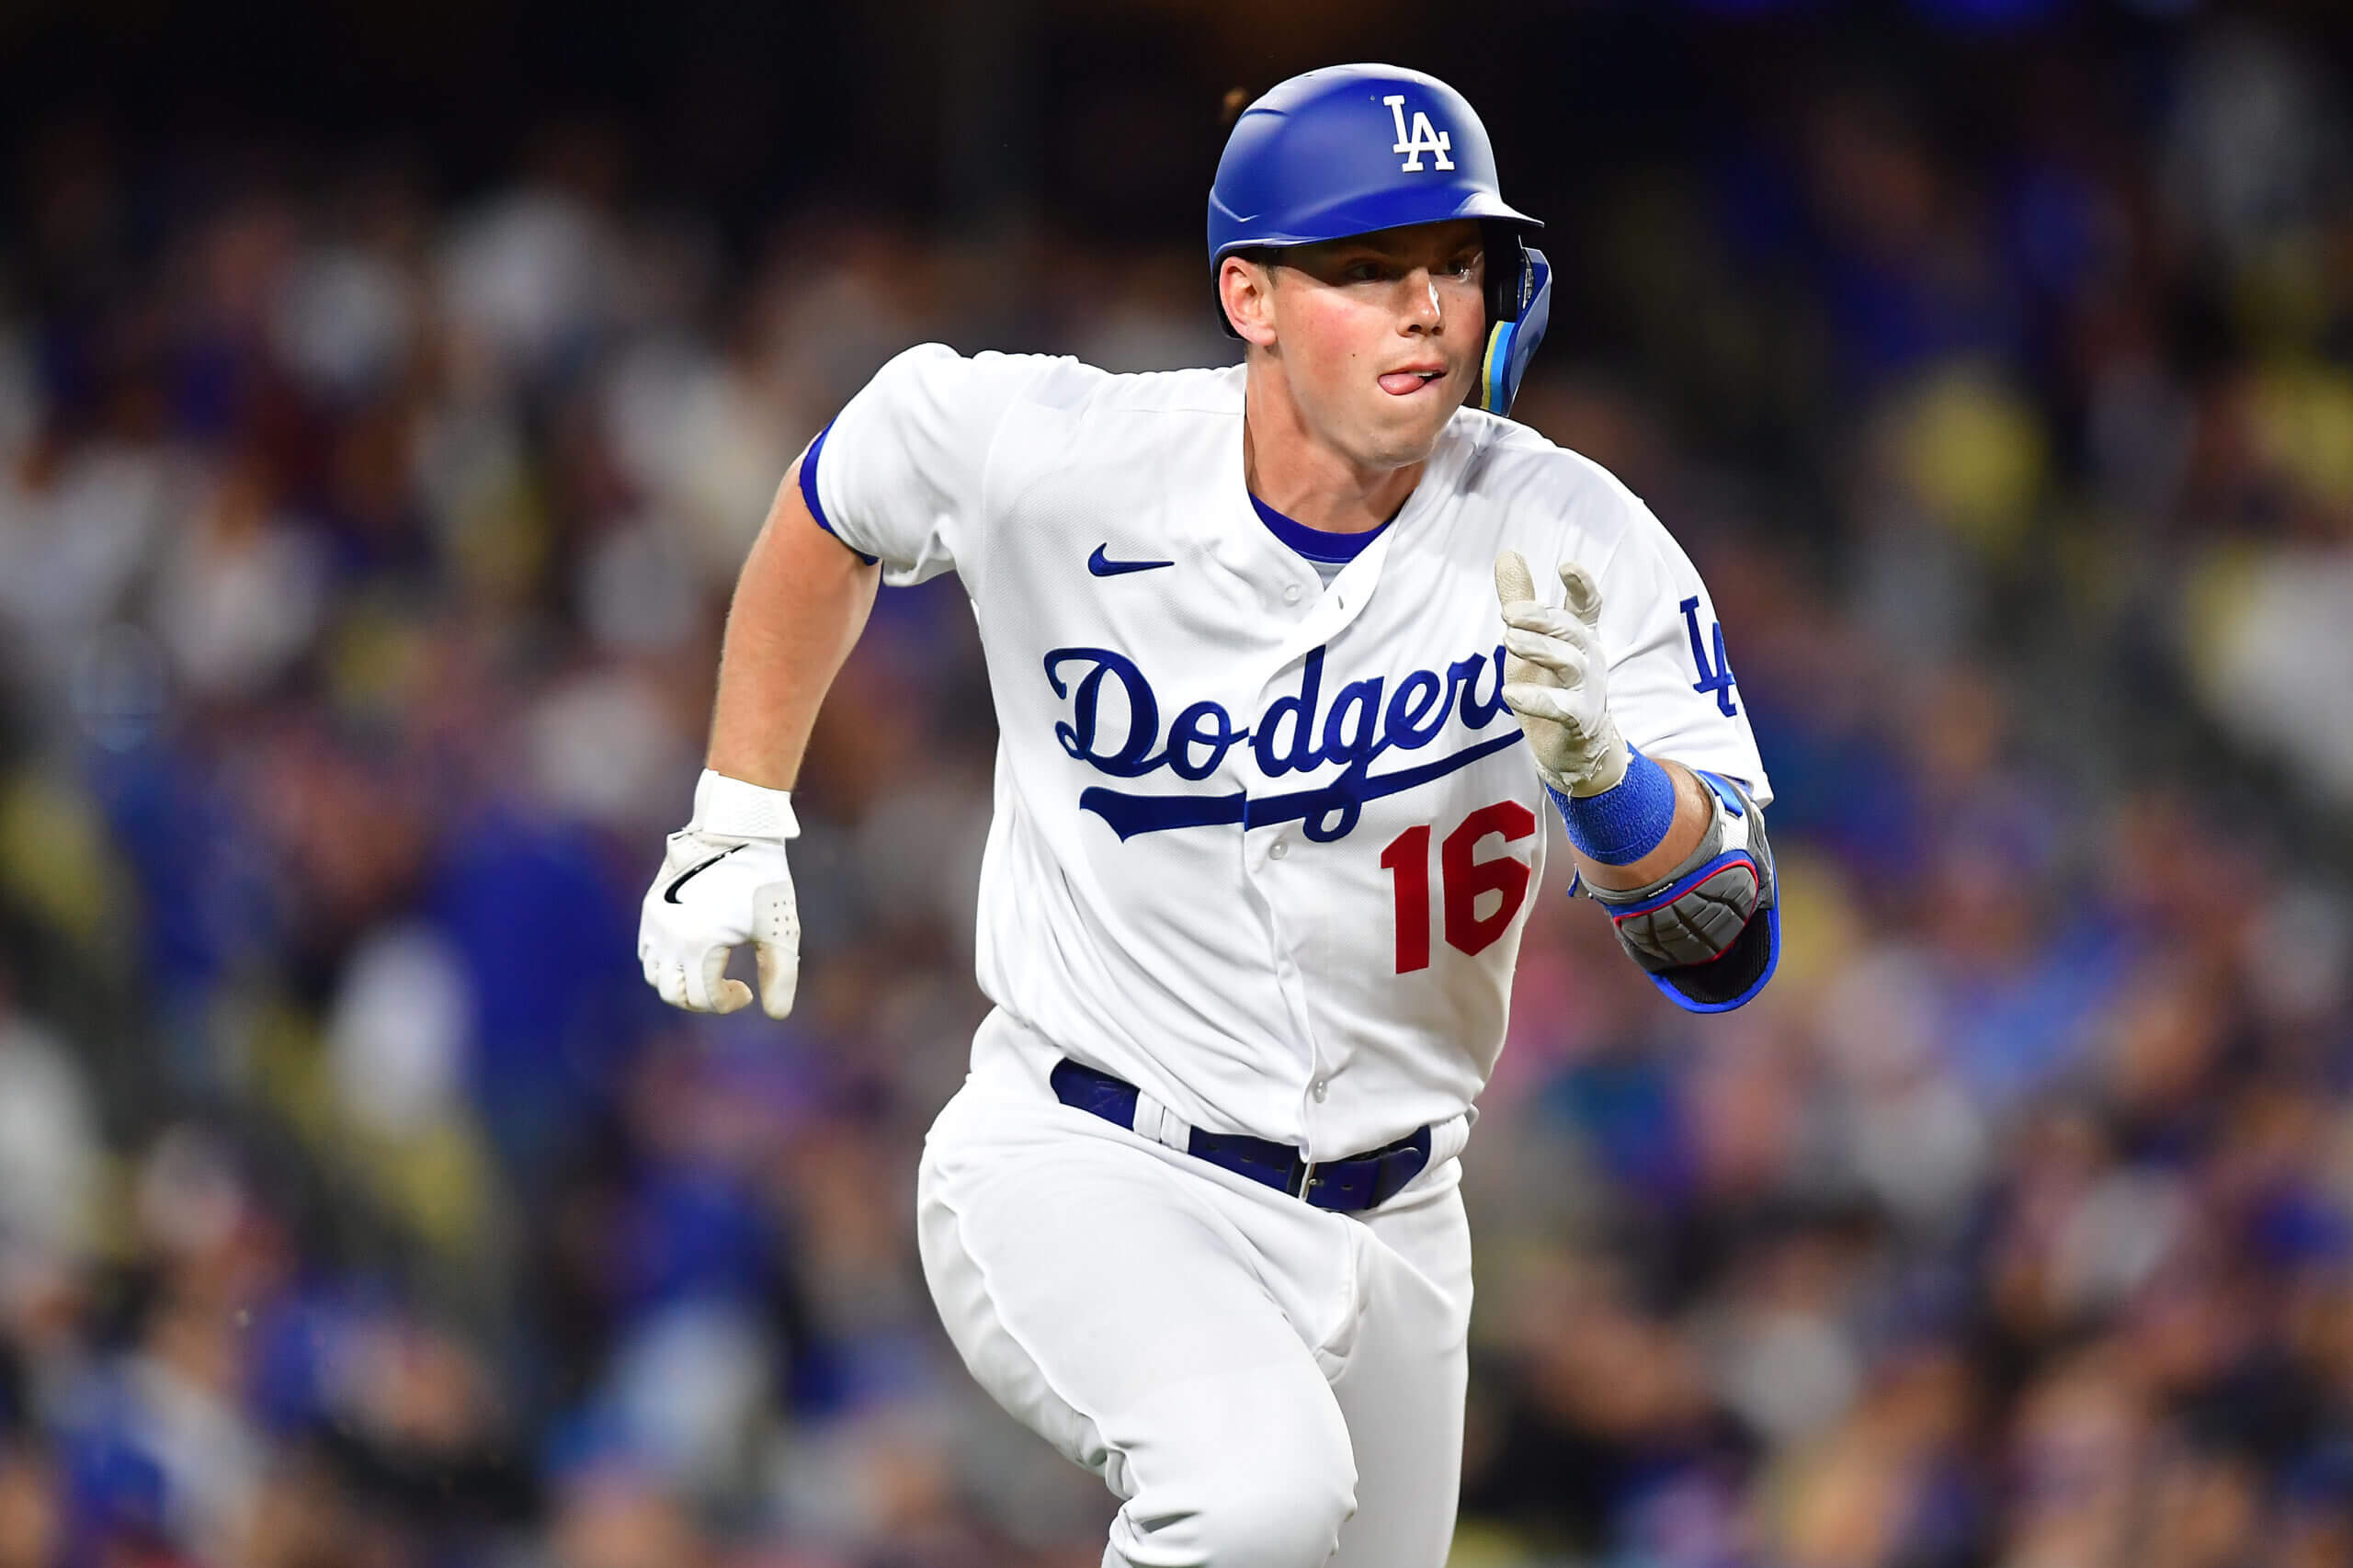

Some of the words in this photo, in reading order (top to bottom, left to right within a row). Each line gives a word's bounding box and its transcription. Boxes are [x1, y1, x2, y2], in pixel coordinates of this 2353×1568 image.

[1382, 95, 1455, 173] LA
[1043, 643, 1516, 843] Dodger
[1380, 799, 1536, 974] 16
